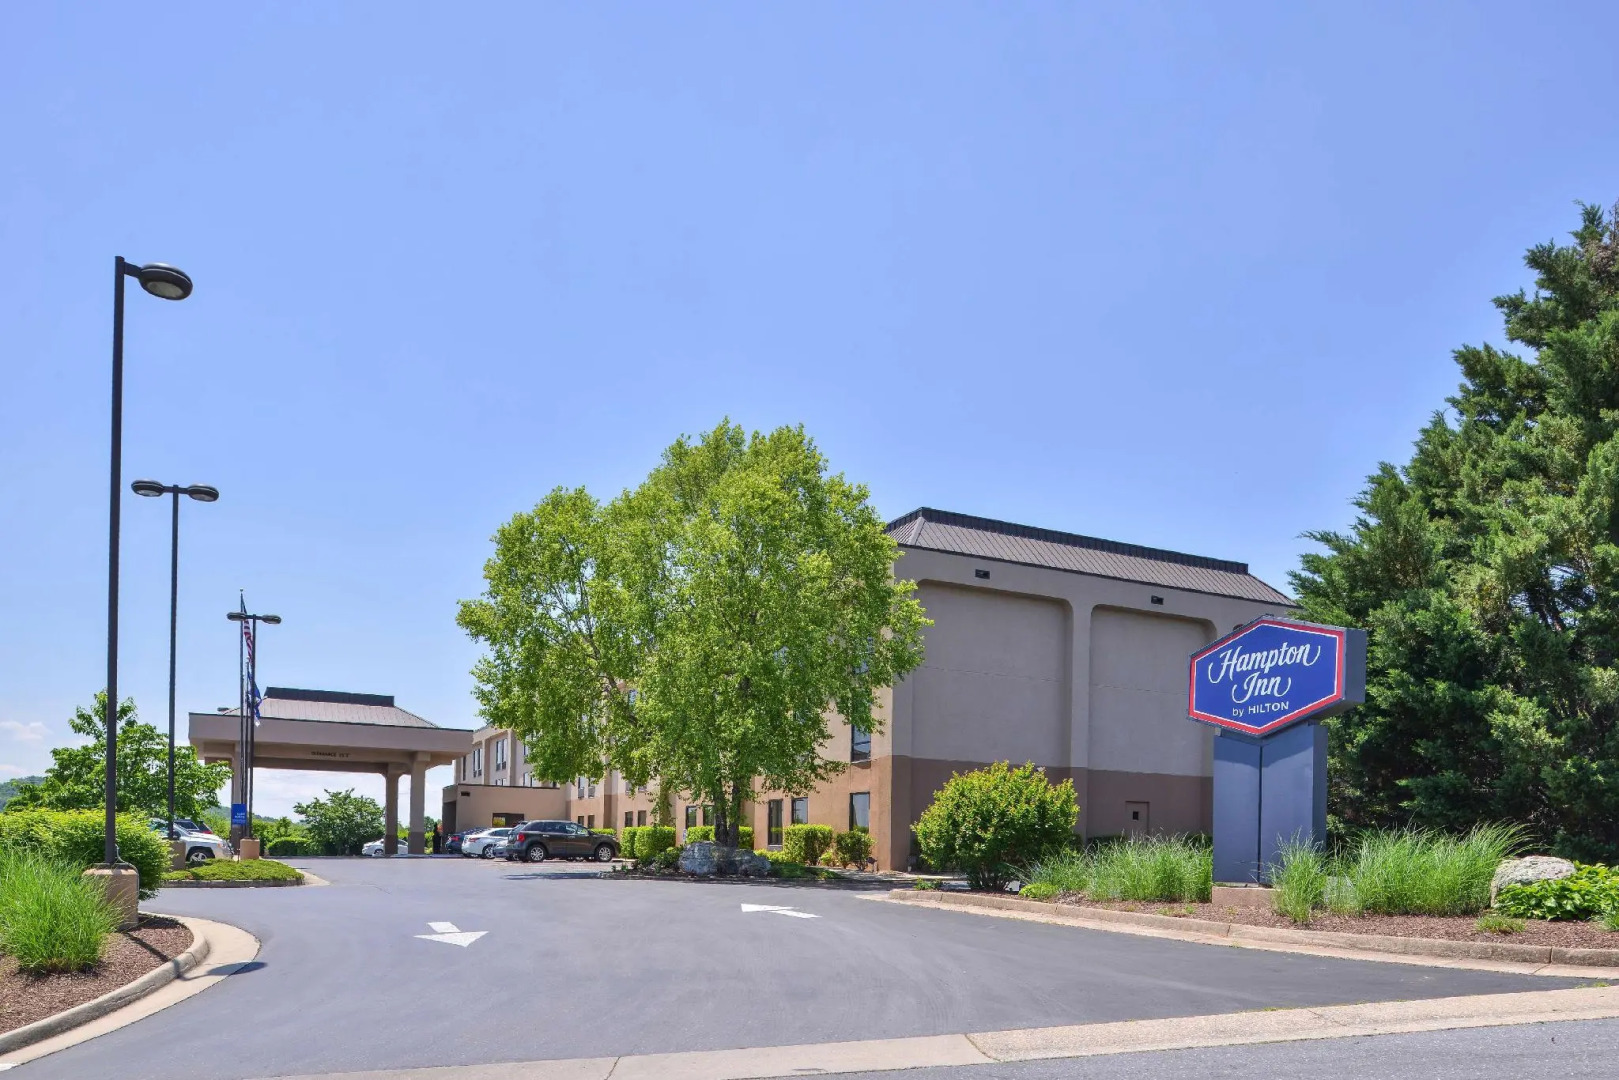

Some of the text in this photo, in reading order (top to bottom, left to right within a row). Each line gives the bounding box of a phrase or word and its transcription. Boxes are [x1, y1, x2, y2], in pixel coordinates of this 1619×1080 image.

[1208, 642, 1321, 683] Hampton
[1231, 671, 1292, 704] Inn
[1232, 701, 1289, 717] by HILTON
